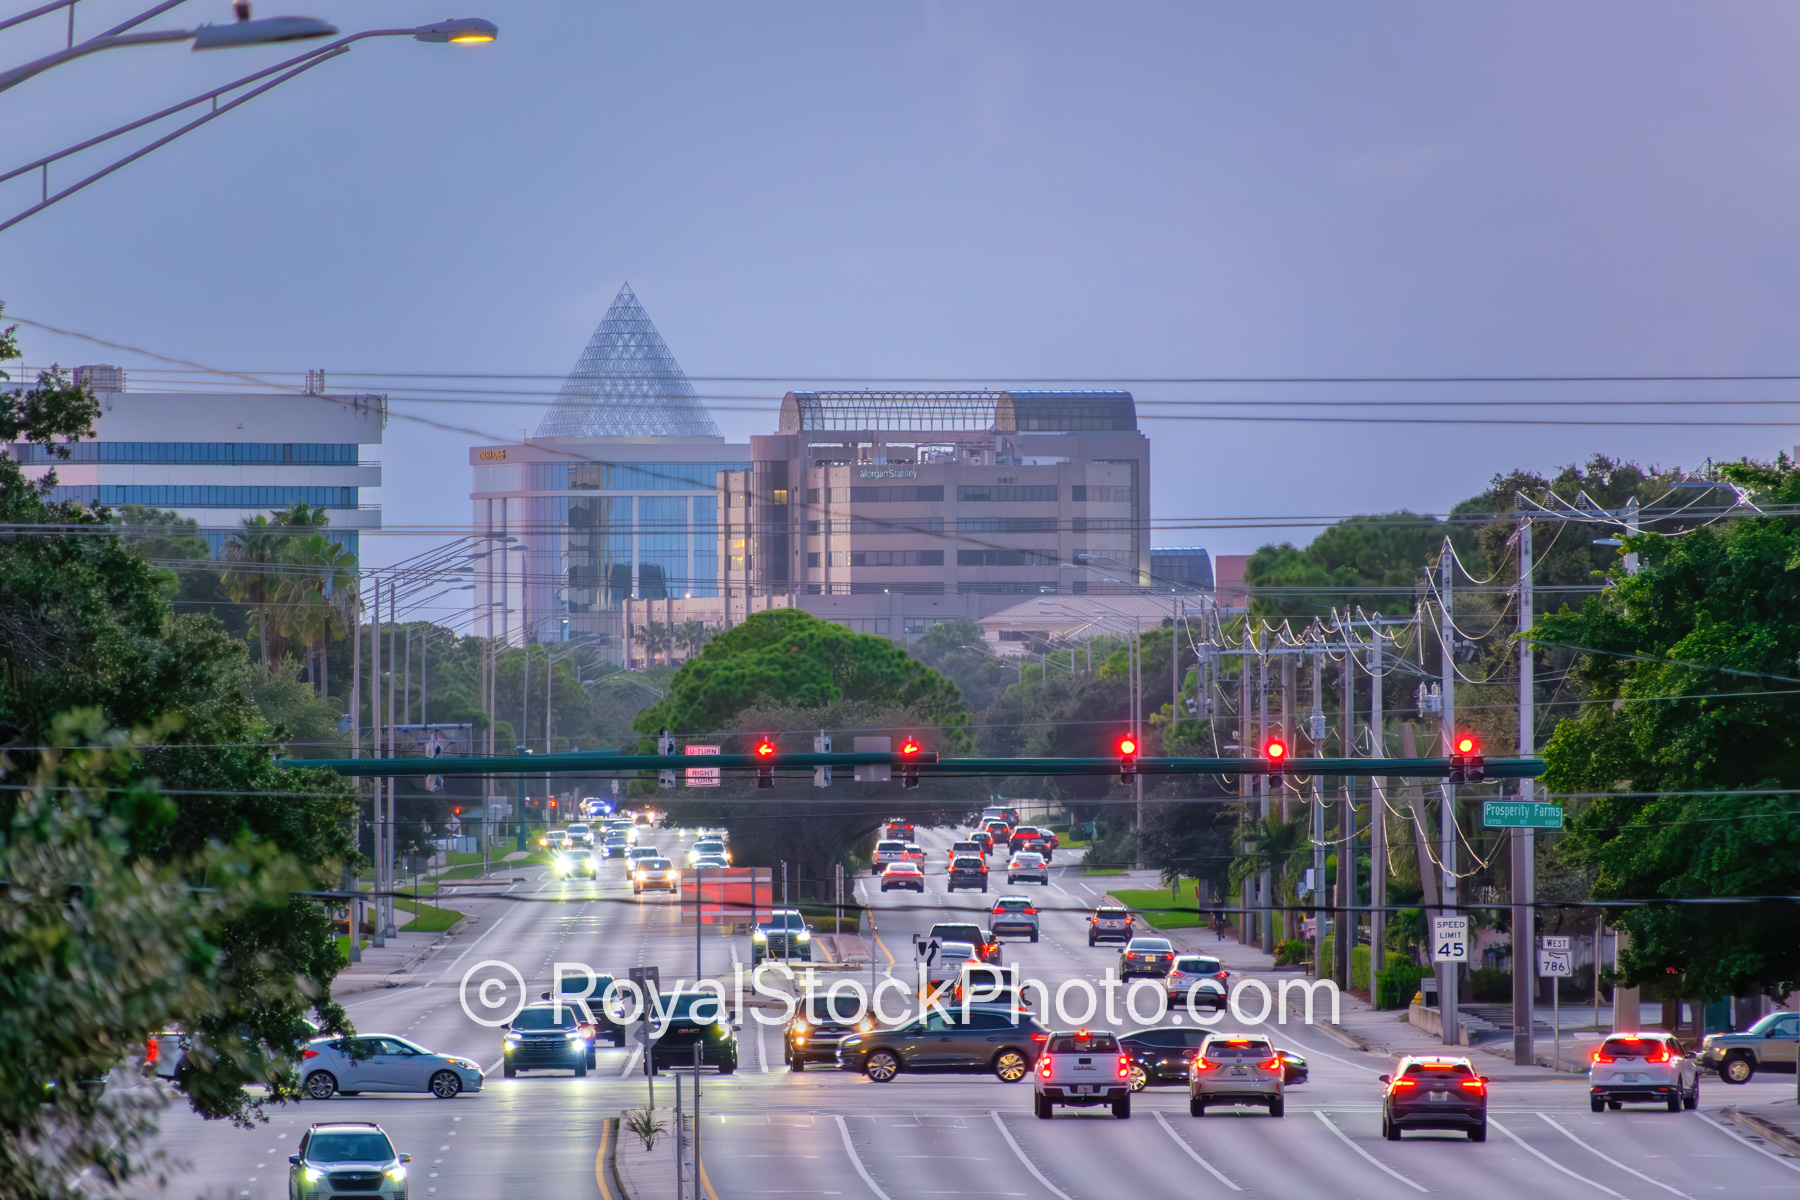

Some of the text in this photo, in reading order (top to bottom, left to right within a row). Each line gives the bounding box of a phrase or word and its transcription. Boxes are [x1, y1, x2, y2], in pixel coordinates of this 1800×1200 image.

[1486, 803, 1560, 819] Prosperity Farms
[1437, 942, 1464, 957] 45
[1546, 939, 1567, 948] WEST
[1543, 961, 1565, 972] 786
